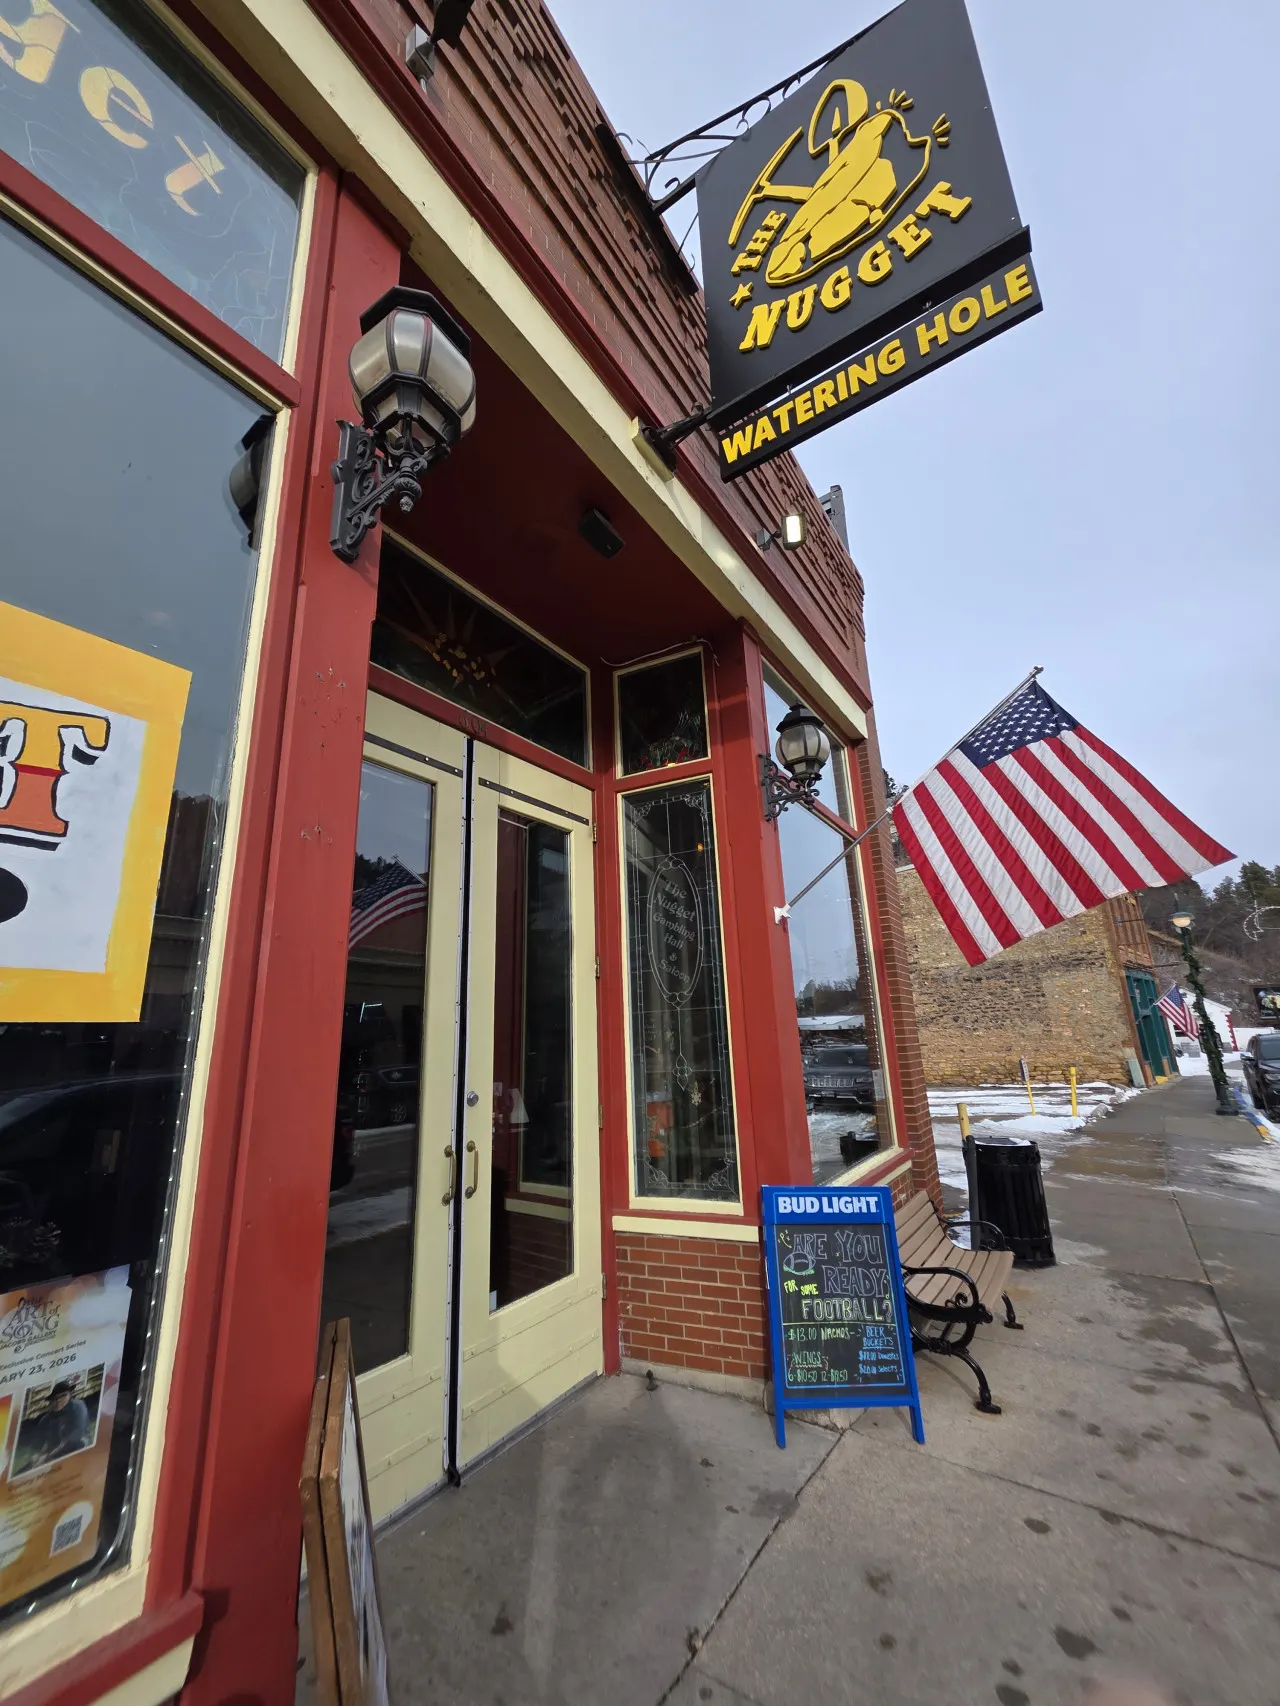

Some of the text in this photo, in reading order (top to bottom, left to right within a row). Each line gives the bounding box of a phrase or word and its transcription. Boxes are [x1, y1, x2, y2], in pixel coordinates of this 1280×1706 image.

[731, 210, 788, 277] THE
[739, 181, 972, 352] NUGGET
[722, 263, 1033, 463] WATERING HOLE
[665, 879, 688, 899] The
[653, 892, 696, 922] Nugget
[653, 911, 696, 941] Gambling
[664, 932, 684, 950] Hall
[669, 952, 678, 961] &
[660, 959, 690, 984] Saloon
[778, 1196, 879, 1213] BUD LIGHT
[793, 1230, 883, 1264] ARE YOU
[784, 1279, 819, 1296] FOR SOME
[822, 1265, 887, 1298] READY
[9, 1298, 53, 1325] ART
[801, 1298, 892, 1322] FOOTBALL?
[1, 1314, 60, 1341] SONG
[866, 1326, 885, 1338] BEER
[36, 1346, 64, 1361] Concert
[66, 1340, 87, 1352] Series
[863, 1337, 893, 1347] BUCKETS
[29, 1364, 45, 1376] 23,
[49, 1352, 77, 1370] 2026
[793, 1350, 821, 1365] WINGS
